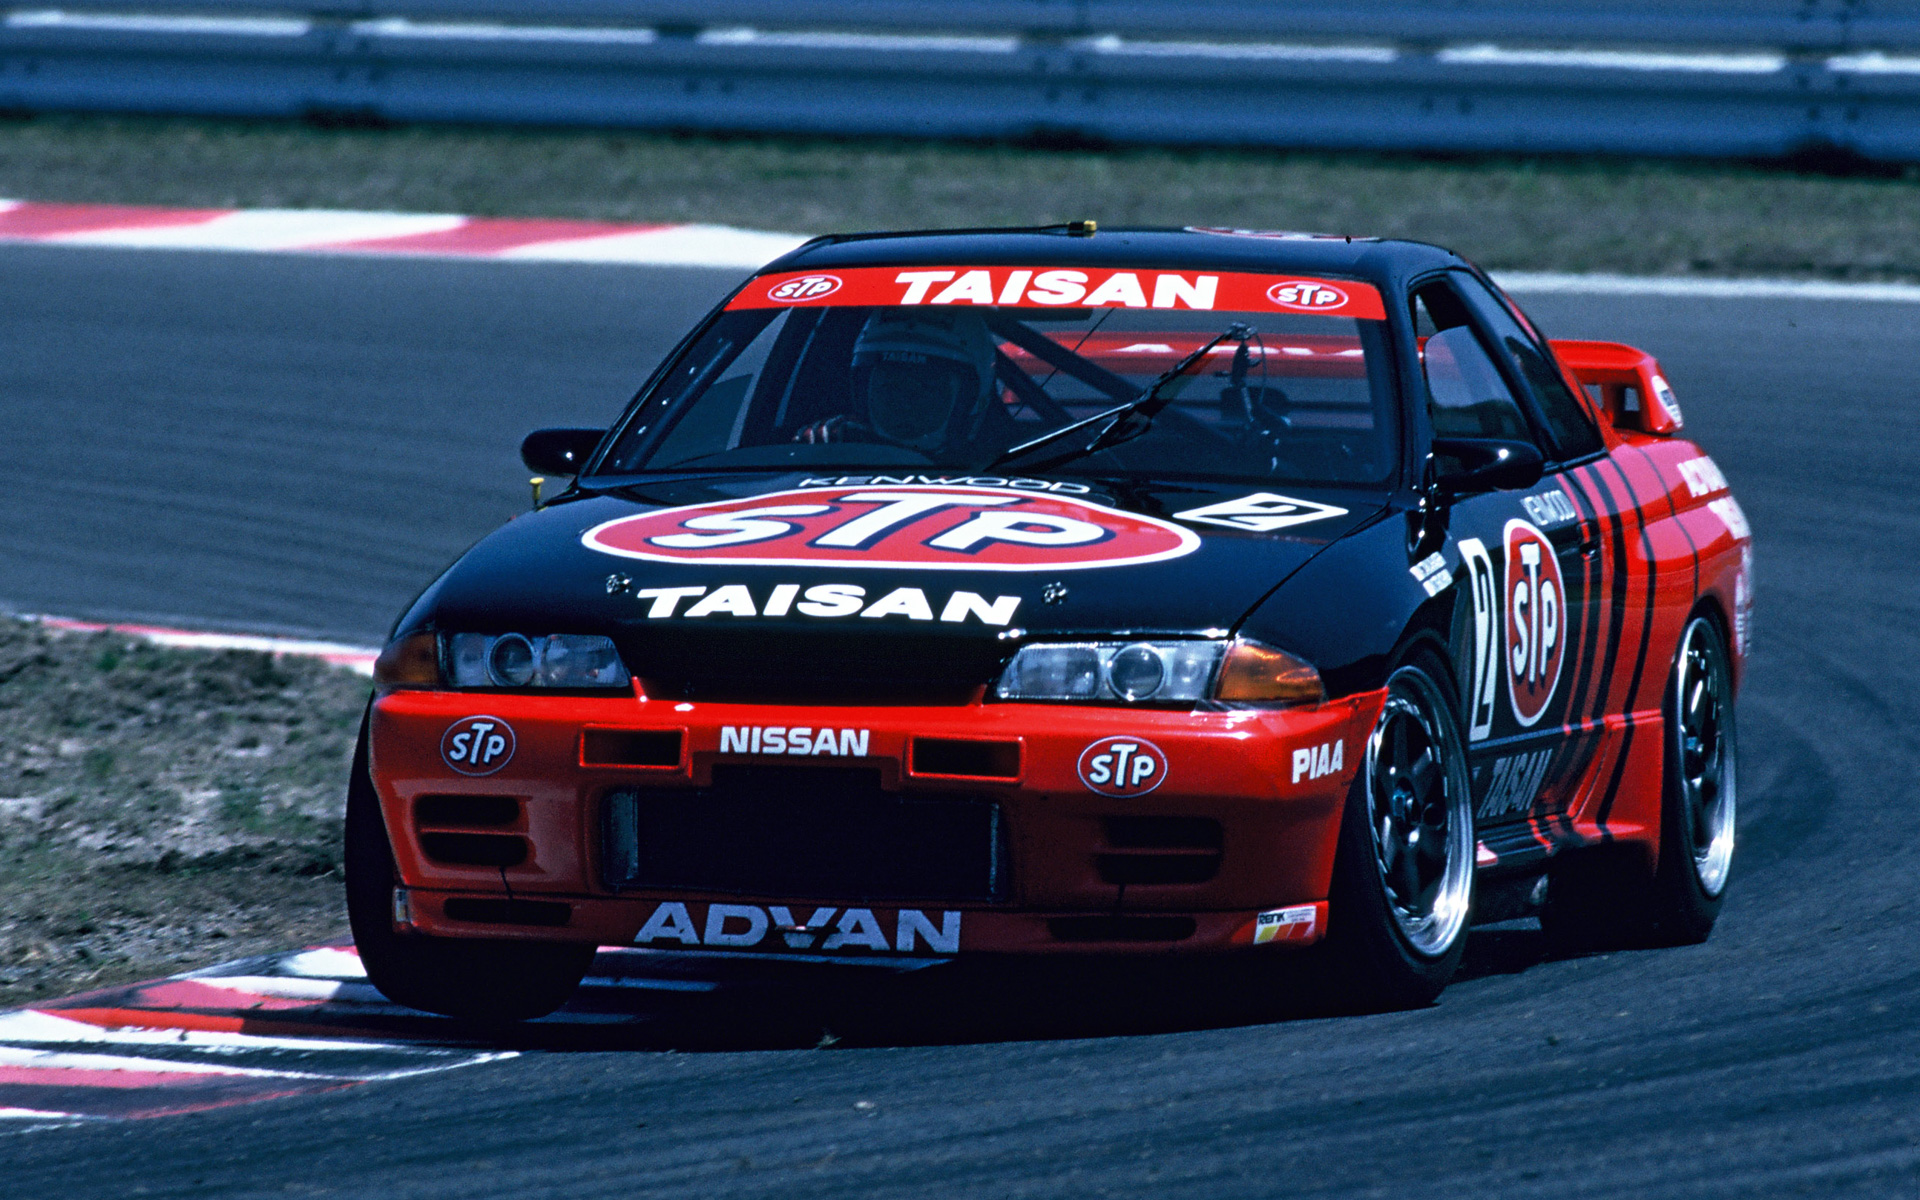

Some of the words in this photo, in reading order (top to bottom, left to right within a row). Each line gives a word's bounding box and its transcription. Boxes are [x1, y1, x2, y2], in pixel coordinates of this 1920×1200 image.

[775, 278, 832, 298] STP
[895, 270, 1218, 310] TAISAN
[1278, 284, 1337, 305] STP
[799, 475, 1090, 494] KENWOOD
[651, 492, 1105, 551] STP
[636, 584, 1021, 625] TAISAN
[1513, 543, 1557, 683] STP
[449, 722, 505, 764] STP
[720, 726, 870, 757] NISSAN
[1292, 739, 1343, 784] PIAA
[1089, 743, 1155, 786] STP
[634, 902, 962, 953] ADVAN
